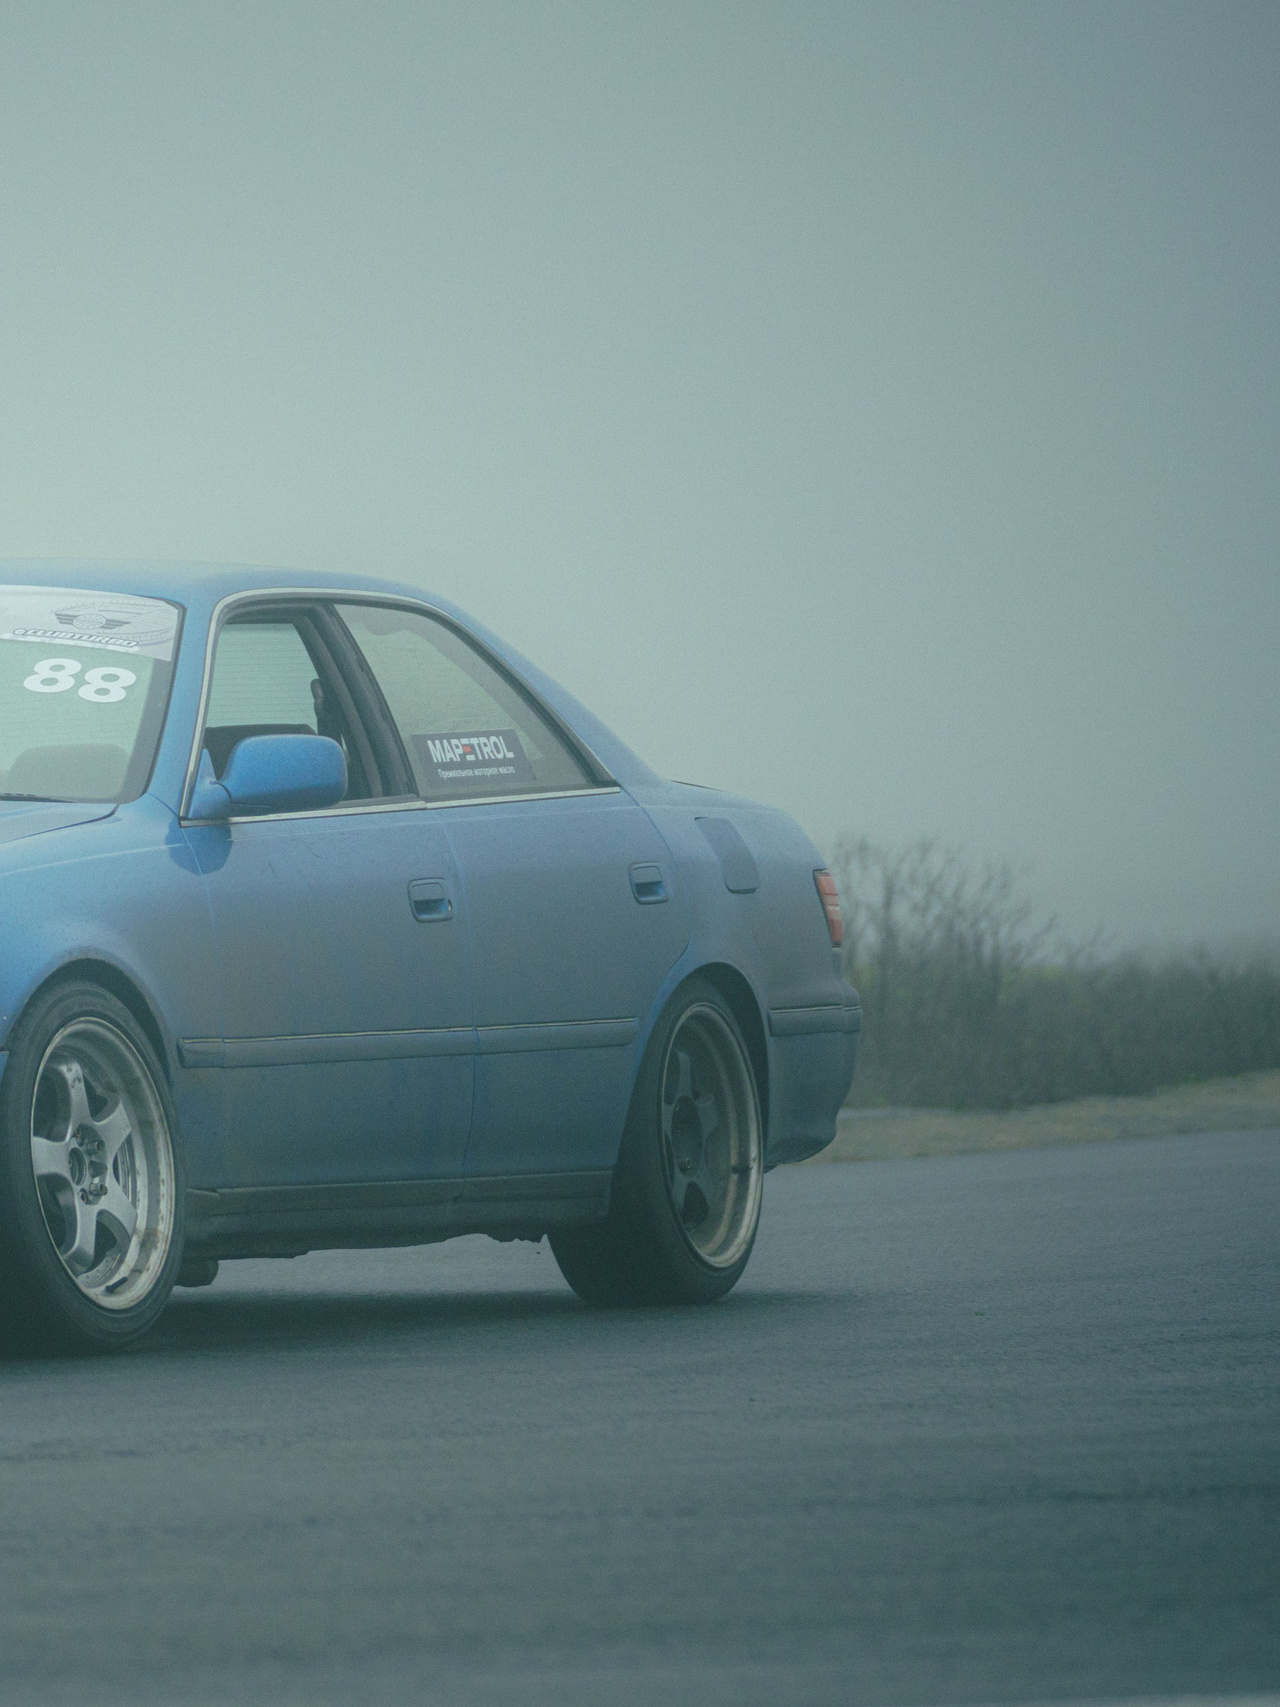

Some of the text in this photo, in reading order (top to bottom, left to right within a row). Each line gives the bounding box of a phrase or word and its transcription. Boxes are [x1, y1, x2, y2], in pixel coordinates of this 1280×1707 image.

[24, 629, 139, 648] CLUBTURBO
[23, 657, 137, 703] 88
[427, 735, 515, 763] MAPETROL
